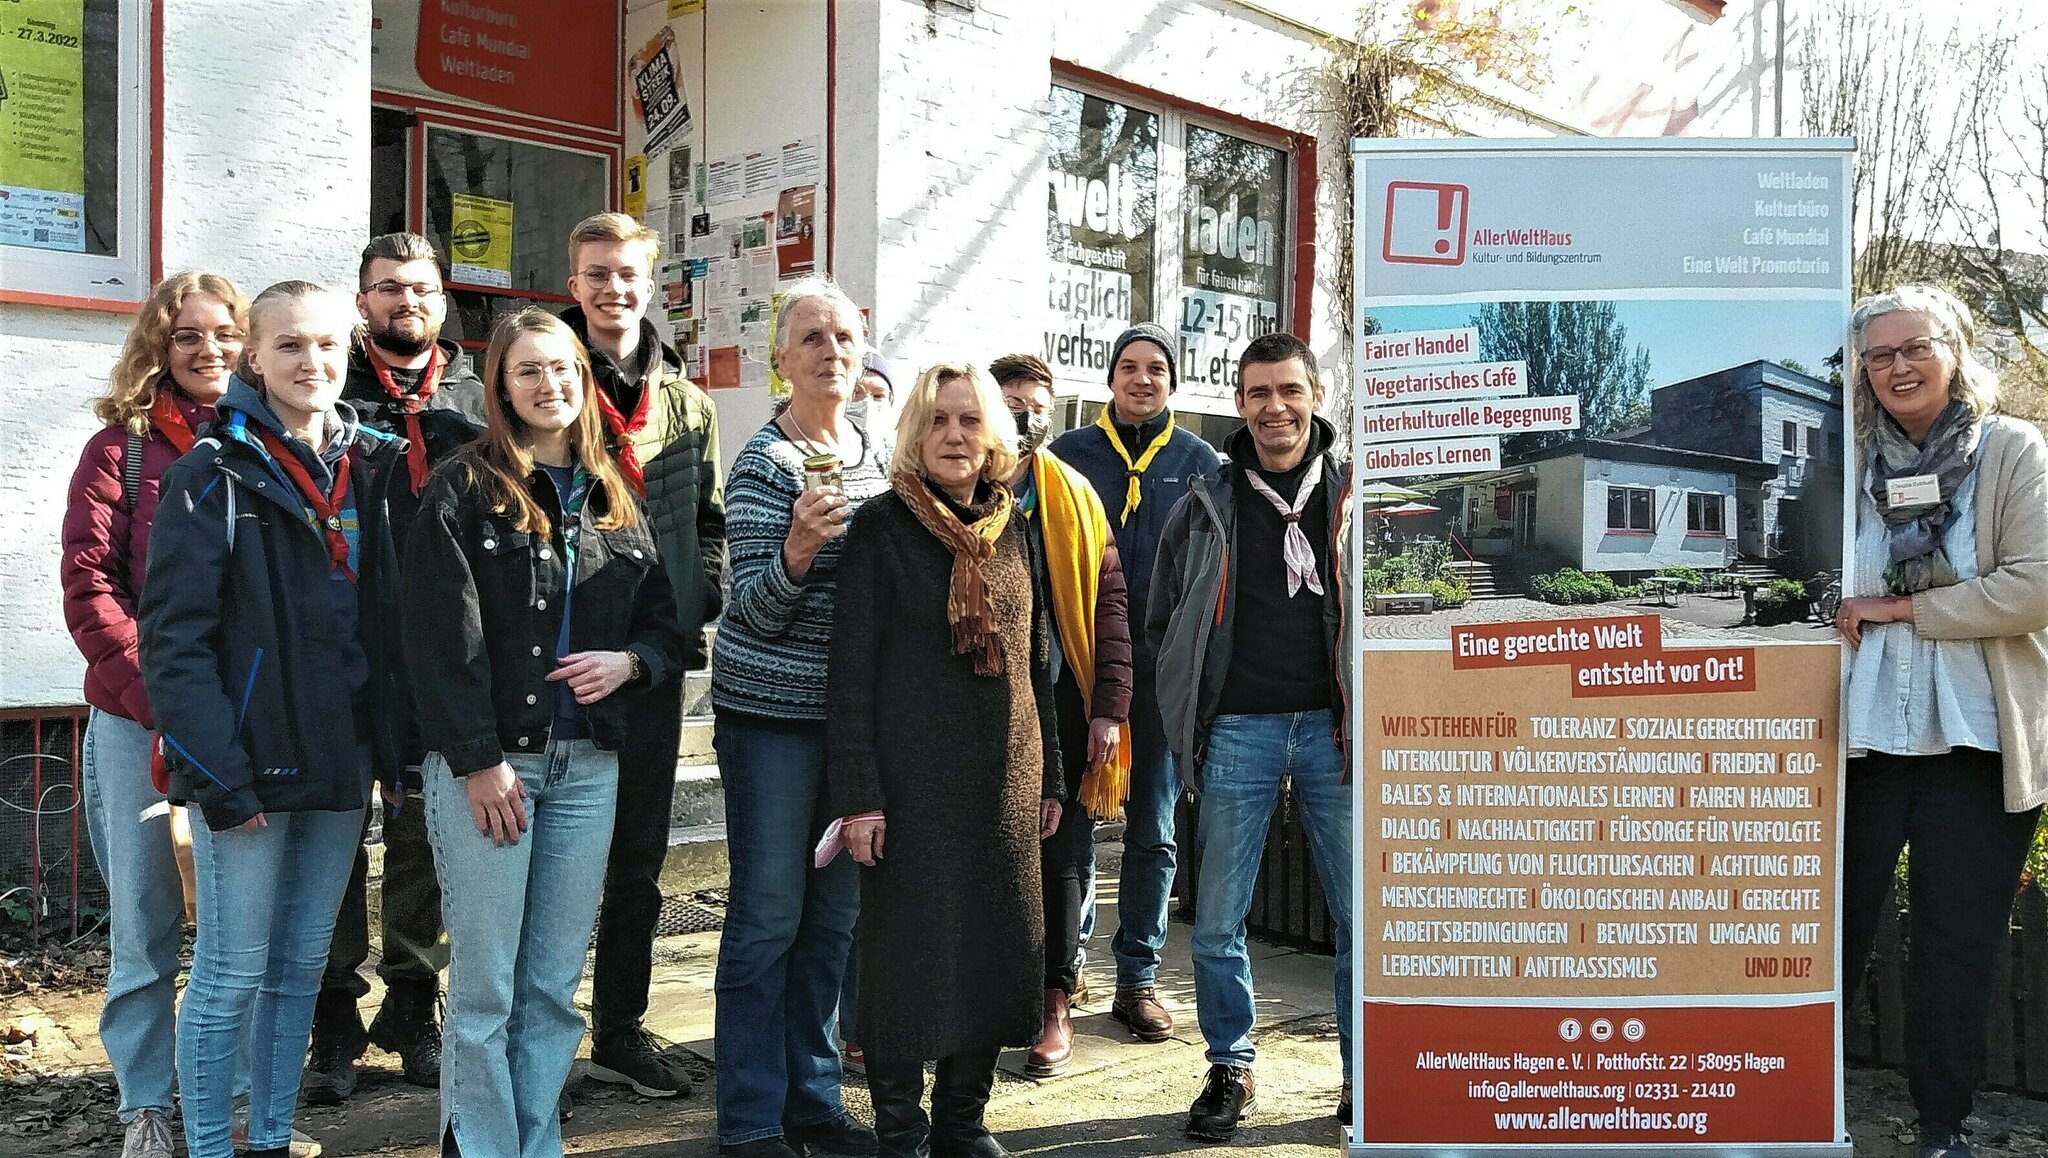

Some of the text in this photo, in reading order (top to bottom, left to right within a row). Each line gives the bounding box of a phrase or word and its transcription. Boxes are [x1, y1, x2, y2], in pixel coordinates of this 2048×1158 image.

[17, 28, 78, 48] 27.3.2022
[476, 31, 530, 59] Mundial
[441, 54, 514, 84] Weltladen
[638, 52, 668, 88] KLIMA
[641, 65, 671, 101] STREIK
[648, 94, 677, 127] 24.09.
[1757, 171, 1829, 190] Weltladen
[1754, 199, 1829, 218] Kulturbüro
[1190, 185, 1274, 266] laden
[1473, 229, 1572, 247] AllerWeltHaus
[1743, 228, 1830, 247] Café Mundial
[1473, 250, 1602, 265] Kultur- und Bildungszentrum
[1683, 256, 1830, 275] Eine Welt Promotorin
[1048, 269, 1129, 321] täglich
[1180, 296, 1242, 343] 12-15
[1365, 331, 1470, 362] Fairer Handel
[1365, 366, 1517, 399] Vegetarisches Café
[1364, 404, 1572, 435] Interkulturelle Begegnung
[1365, 445, 1492, 472] Globales Lernen
[1458, 623, 1643, 661] Eine gerechte Welt
[1578, 657, 1743, 687] entsteht vor Ort!
[1381, 711, 1816, 740] WIR STEHEN FÜR TOLERANZ SOZIALE GERECHTIGKEIT
[1381, 745, 1823, 774] INTERKULTUR VÖLKERVERSTÄNDIGUNG FRIEDEN GLO-
[1381, 784, 1813, 808] BALES & INTERNATIONALES LERNEN FAIREN HANDEL
[1381, 814, 1822, 842] DIALOG NACHHALTIGKEIT FÜRSORGE FÜR VERFOLGTE
[1392, 847, 1821, 877] BEKÄMPFUNG VON FLUCHTURSACHEN ACHTUNG DER
[1381, 882, 1820, 911] MENSCHENRECHTE ÖKOLOGISCHEN ANBAU GERECHTE
[1382, 920, 1820, 945] ARBEITSBEDINGUNGEN BEWUSSTEN UMGANG MIT
[1382, 954, 1812, 978] LEBENSMITTELN ANTIRASSISMUS UND DU?
[1416, 1052, 1785, 1073] AllerWeltHaus Hagen e. V. Potthofstr. 22 58095 Hagen
[1468, 1081, 1625, 1102] info@allerwelthaus.org
[1635, 1082, 1679, 1098] 02331
[1691, 1082, 1736, 1098] 21410
[1494, 1107, 1708, 1135] www.allerwelthaus.org
